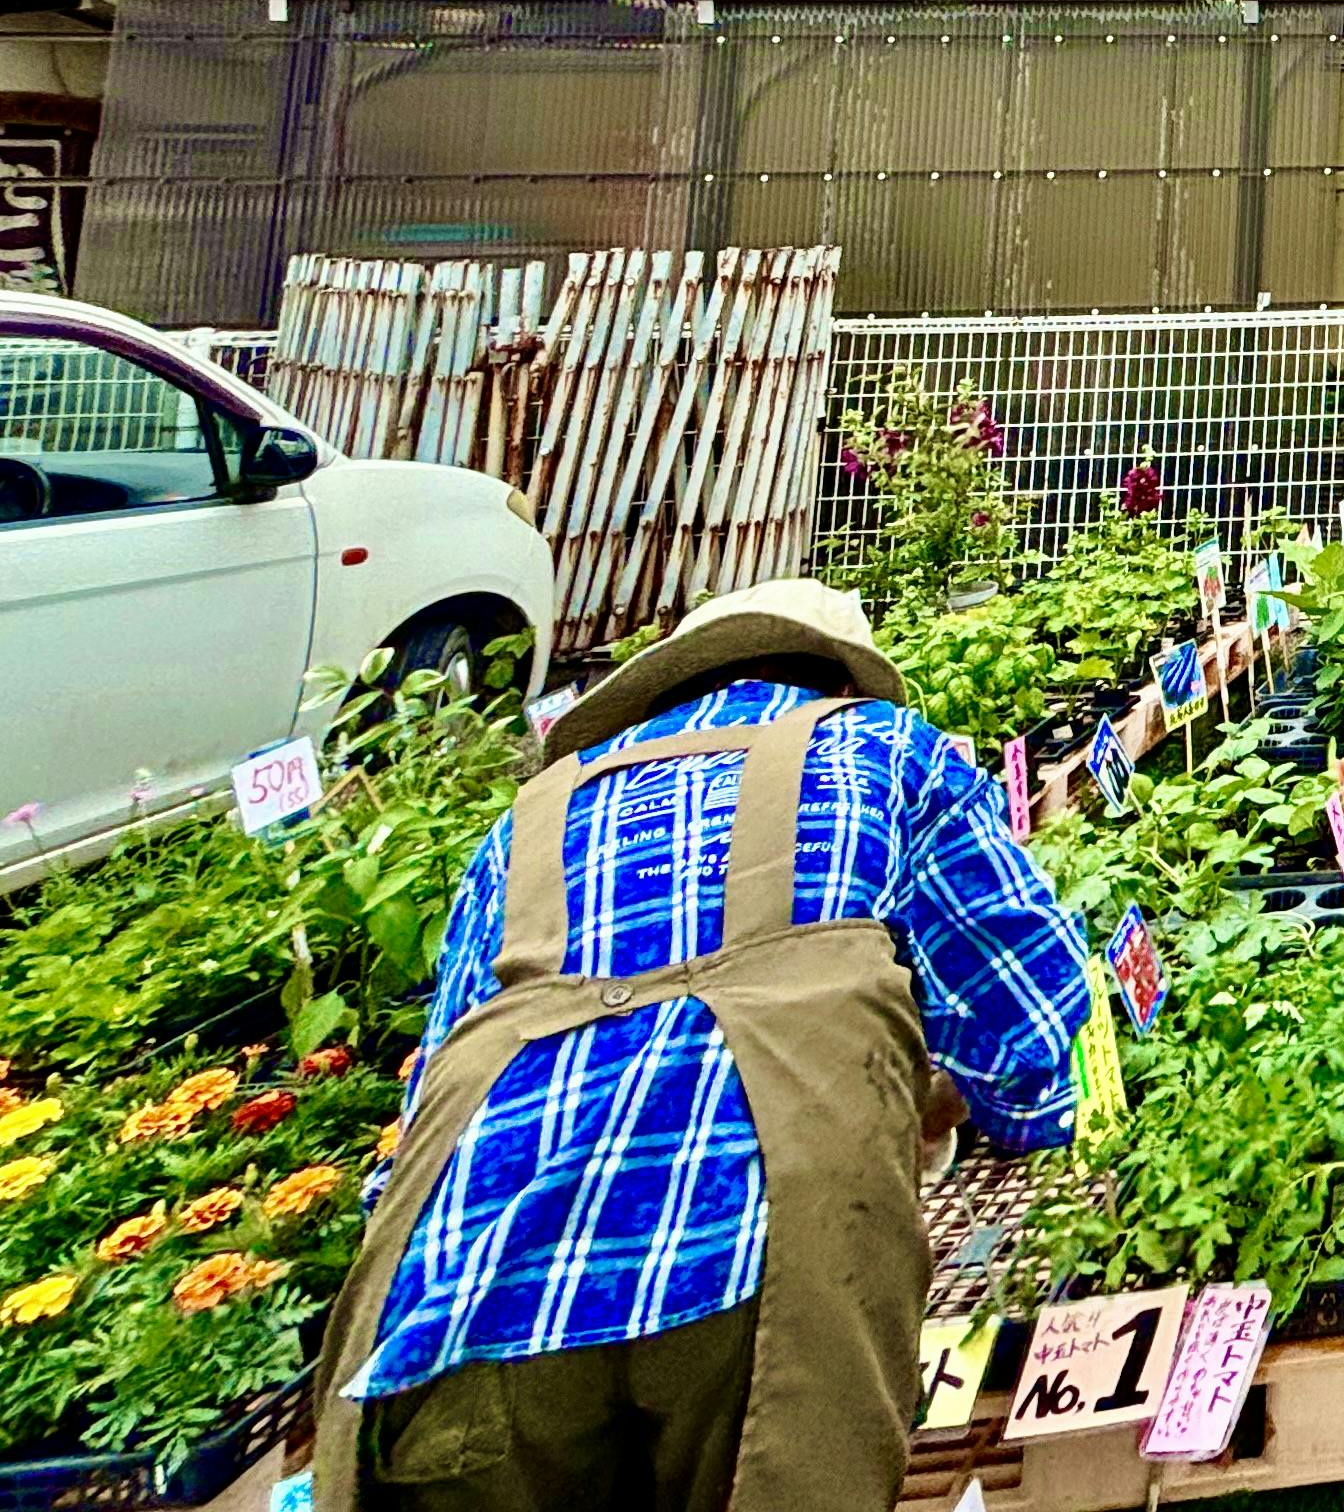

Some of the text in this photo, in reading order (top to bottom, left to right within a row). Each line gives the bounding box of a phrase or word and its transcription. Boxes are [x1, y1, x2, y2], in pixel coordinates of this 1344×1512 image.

[1034, 1336, 1111, 1365] 中玉トマト
[1208, 1294, 1267, 1413] 中玉トマト
